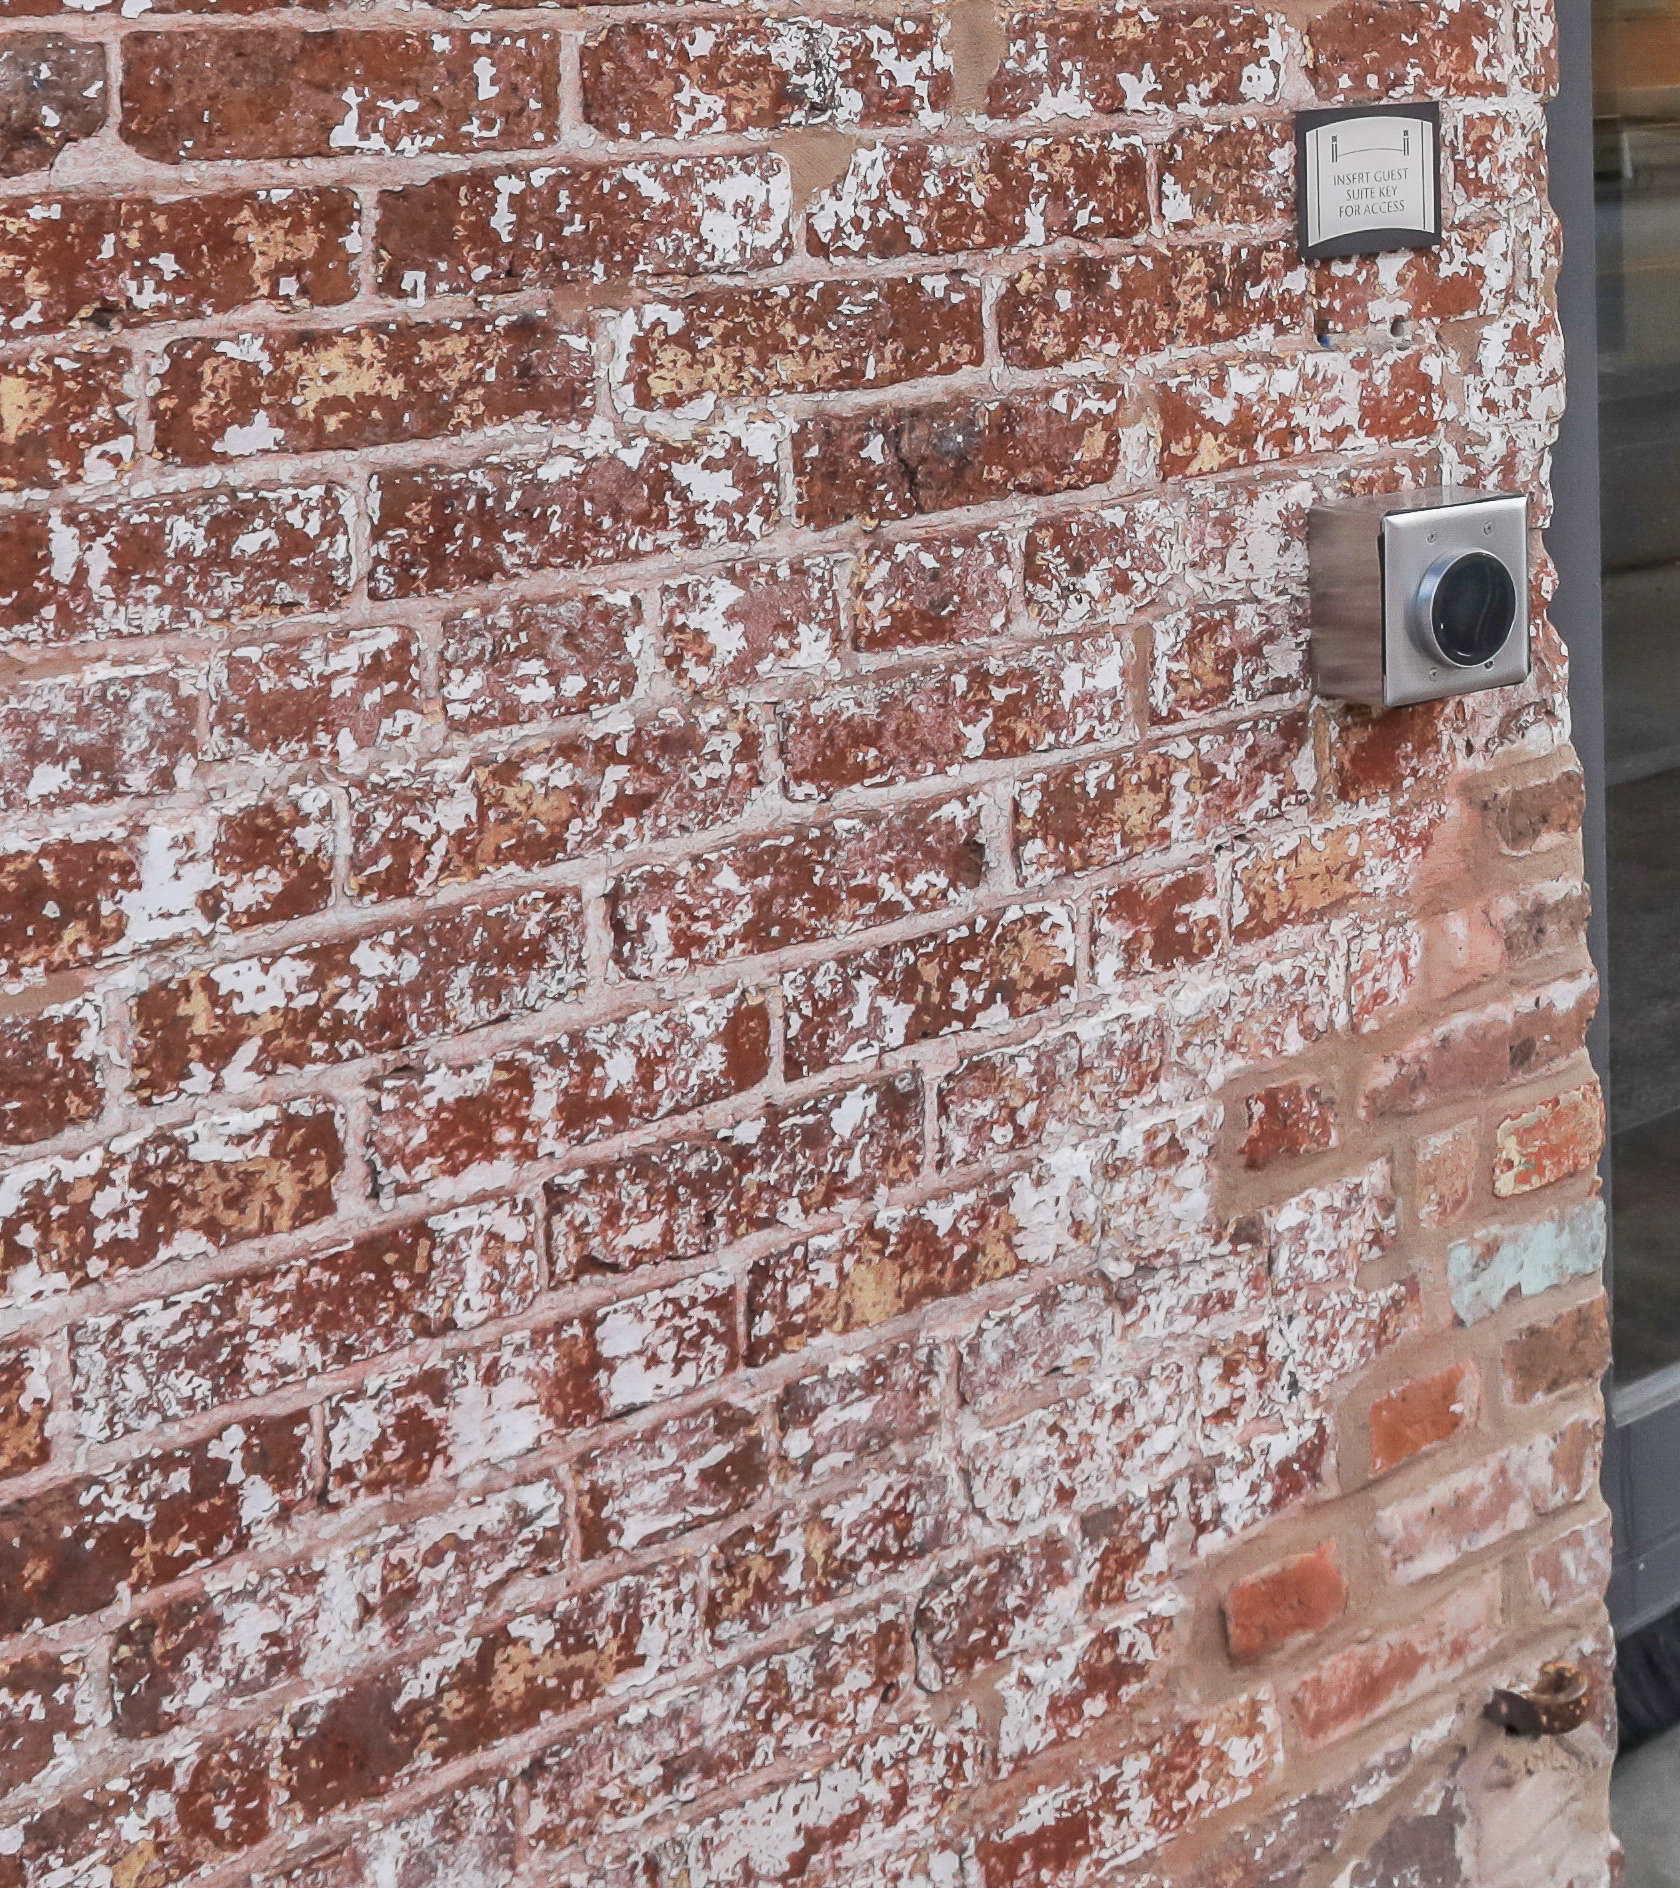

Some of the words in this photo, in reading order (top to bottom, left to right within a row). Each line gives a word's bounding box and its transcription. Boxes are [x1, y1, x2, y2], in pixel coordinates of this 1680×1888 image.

[1333, 171, 1370, 186] INSERT
[1373, 167, 1409, 183] GUEST
[1345, 186, 1376, 201] SUITE
[1379, 185, 1398, 198] KEY
[1338, 203, 1361, 218] FOR
[1363, 199, 1405, 215] ACCESS
